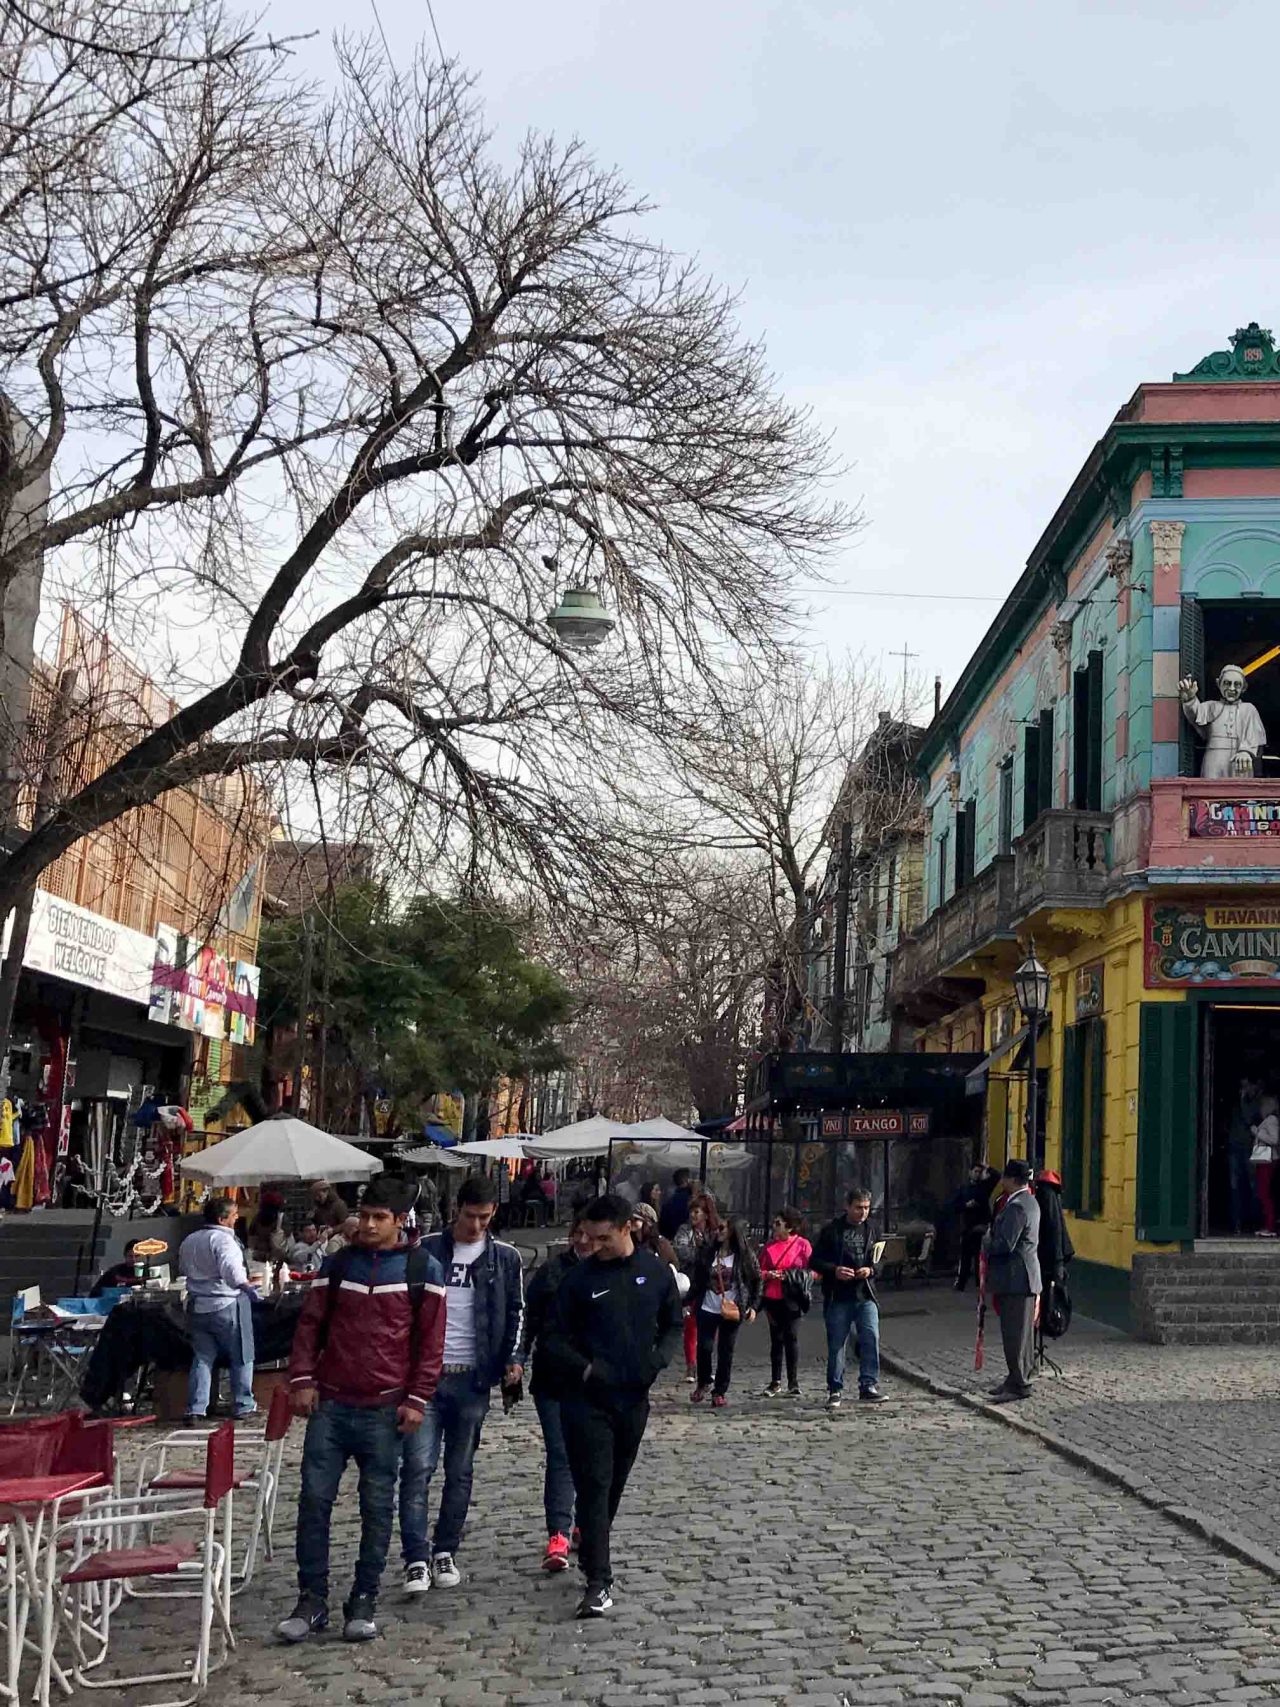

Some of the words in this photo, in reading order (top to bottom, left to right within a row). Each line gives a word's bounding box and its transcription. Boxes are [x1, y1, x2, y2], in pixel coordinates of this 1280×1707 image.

[1227, 820, 1280, 832] AMIGO
[48, 904, 117, 954] BIENVENIDOS
[54, 942, 107, 982] WELCOME
[853, 1117, 897, 1131] TANGO
